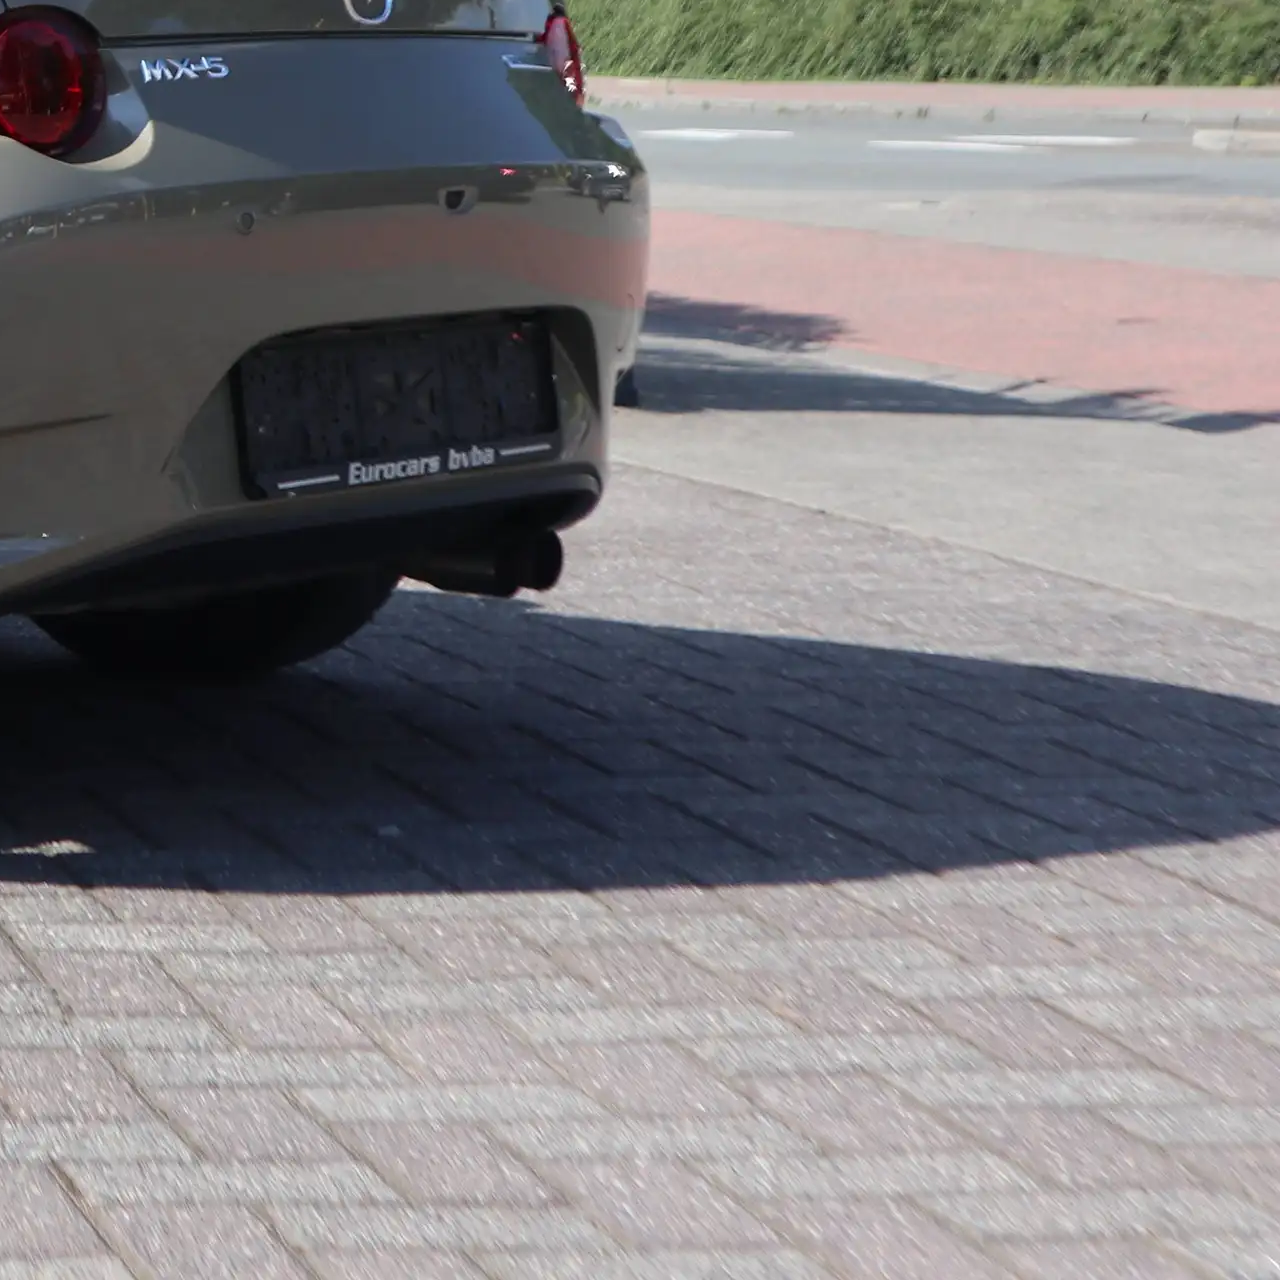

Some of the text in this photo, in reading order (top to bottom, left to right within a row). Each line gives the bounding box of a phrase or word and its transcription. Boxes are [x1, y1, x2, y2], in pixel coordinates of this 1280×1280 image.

[141, 56, 229, 83] MX-5
[348, 445, 496, 486] Eurocars bvba
